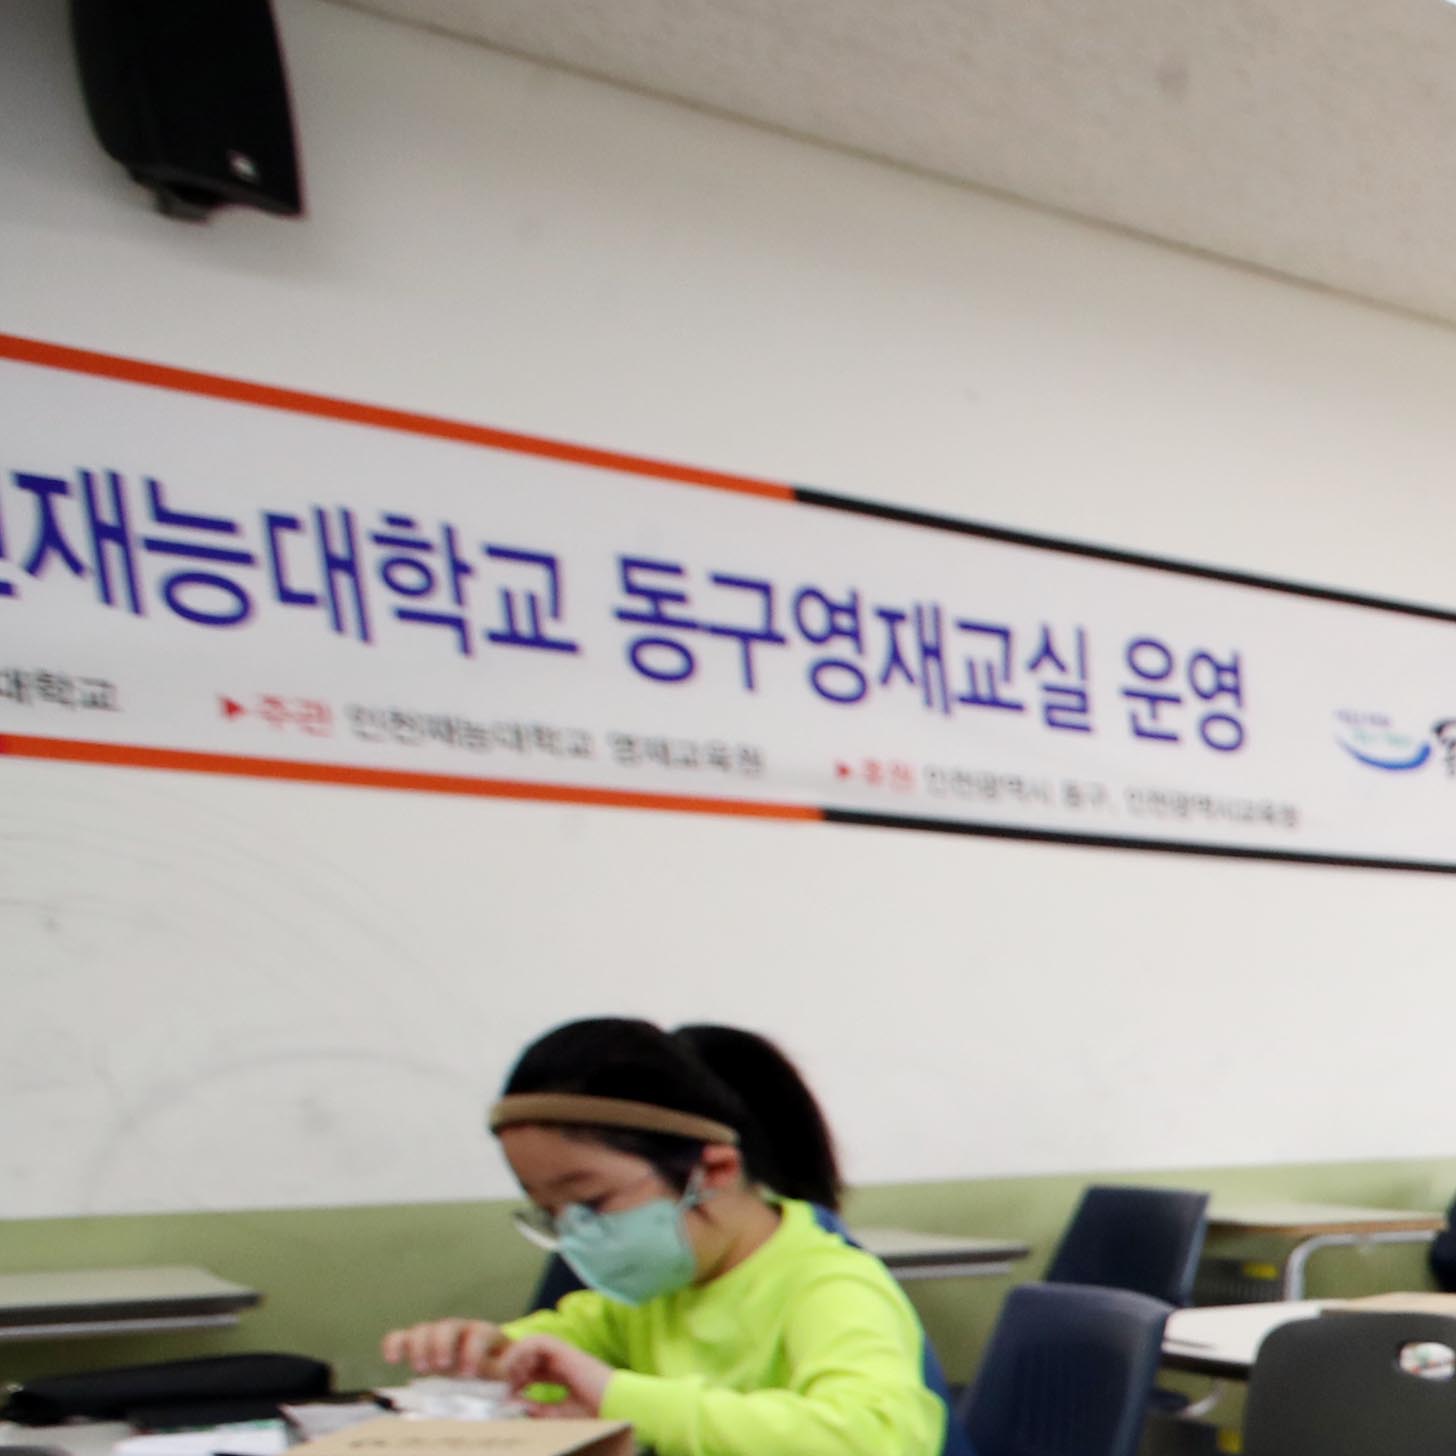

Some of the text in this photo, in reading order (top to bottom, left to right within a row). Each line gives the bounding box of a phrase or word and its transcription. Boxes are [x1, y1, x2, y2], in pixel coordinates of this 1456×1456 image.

[0, 468, 1247, 753] 재능대학교 동구영재교실 운영
